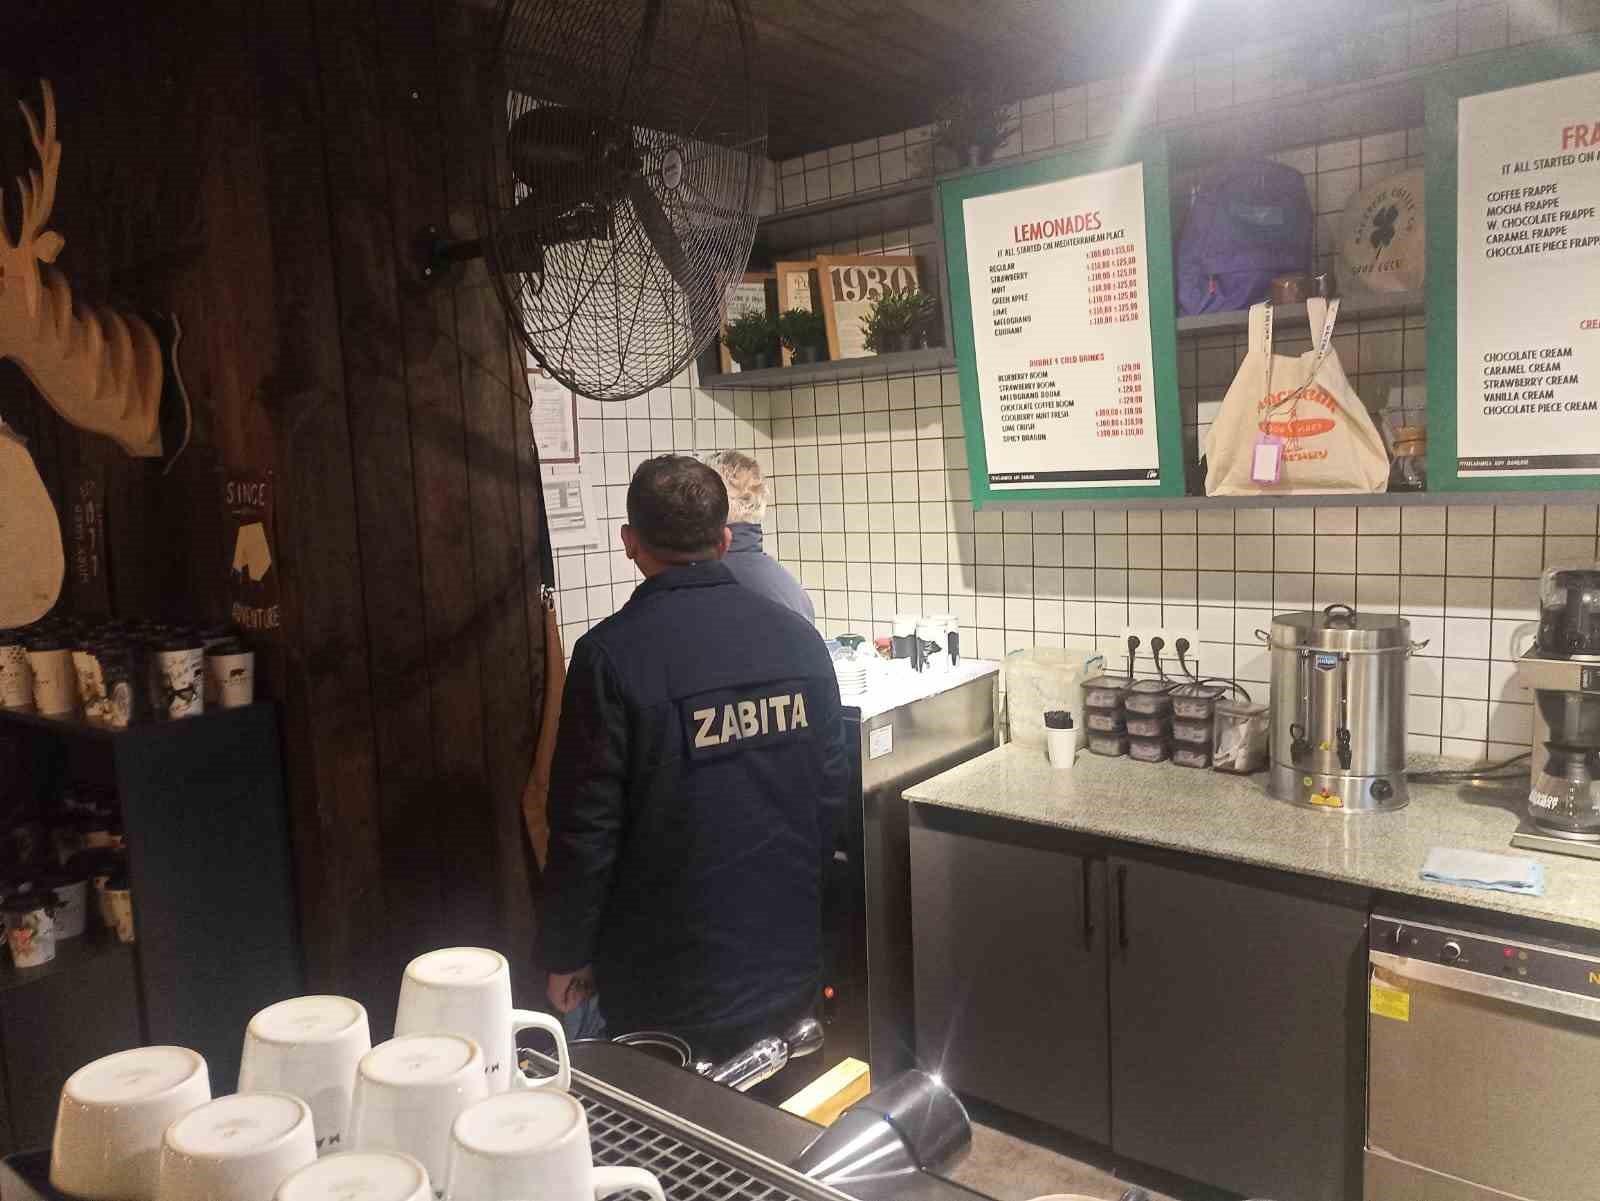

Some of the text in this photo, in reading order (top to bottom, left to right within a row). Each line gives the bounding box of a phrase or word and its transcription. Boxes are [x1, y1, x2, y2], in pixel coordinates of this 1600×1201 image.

[1502, 164, 1511, 175] IT
[1514, 162, 1531, 173] ALL
[1534, 154, 1575, 170] STARTED
[1578, 151, 1595, 164] ON
[1487, 183, 1558, 202] COFFEE FRAPPE
[1487, 197, 1560, 217] MOCHA FRAPPE
[1501, 212, 1557, 229] CHOCOLATE
[1559, 207, 1595, 222] FRAPPE
[1014, 211, 1102, 243] LEMONADES
[1486, 225, 1568, 245] CARAMEL FRAPPE
[1016, 243, 1042, 256] STARTED
[1054, 233, 1105, 248] MEDITERRANEAN
[1106, 229, 1126, 240] PLACE
[1486, 242, 1540, 258] CHOCOLATE
[1542, 239, 1568, 253] PIECE
[989, 262, 1015, 273] REGULAR
[831, 266, 918, 302] 1930
[990, 272, 1028, 283] STRAWBERRY
[1483, 347, 1572, 362] CHOCOLATE CREAM
[998, 373, 1028, 382] BLUEBERRY
[1029, 370, 1048, 379] BOOM
[1483, 362, 1561, 376] CARAMEL CREAM
[998, 382, 1035, 392] STRAWBERRY
[1037, 380, 1056, 389] BOOM
[1483, 374, 1579, 389] STRAWBERRY CREAM
[1483, 389, 1554, 402] VANILLA CREAM
[1000, 402, 1033, 412] CHOCOLATE
[1056, 399, 1075, 408] BOOM
[1051, 409, 1069, 419] FRESH
[1483, 400, 1598, 416] CHOCOLATE PIECE CREAM
[226, 481, 266, 507] SINCE
[693, 693, 809, 748] ZABITA
